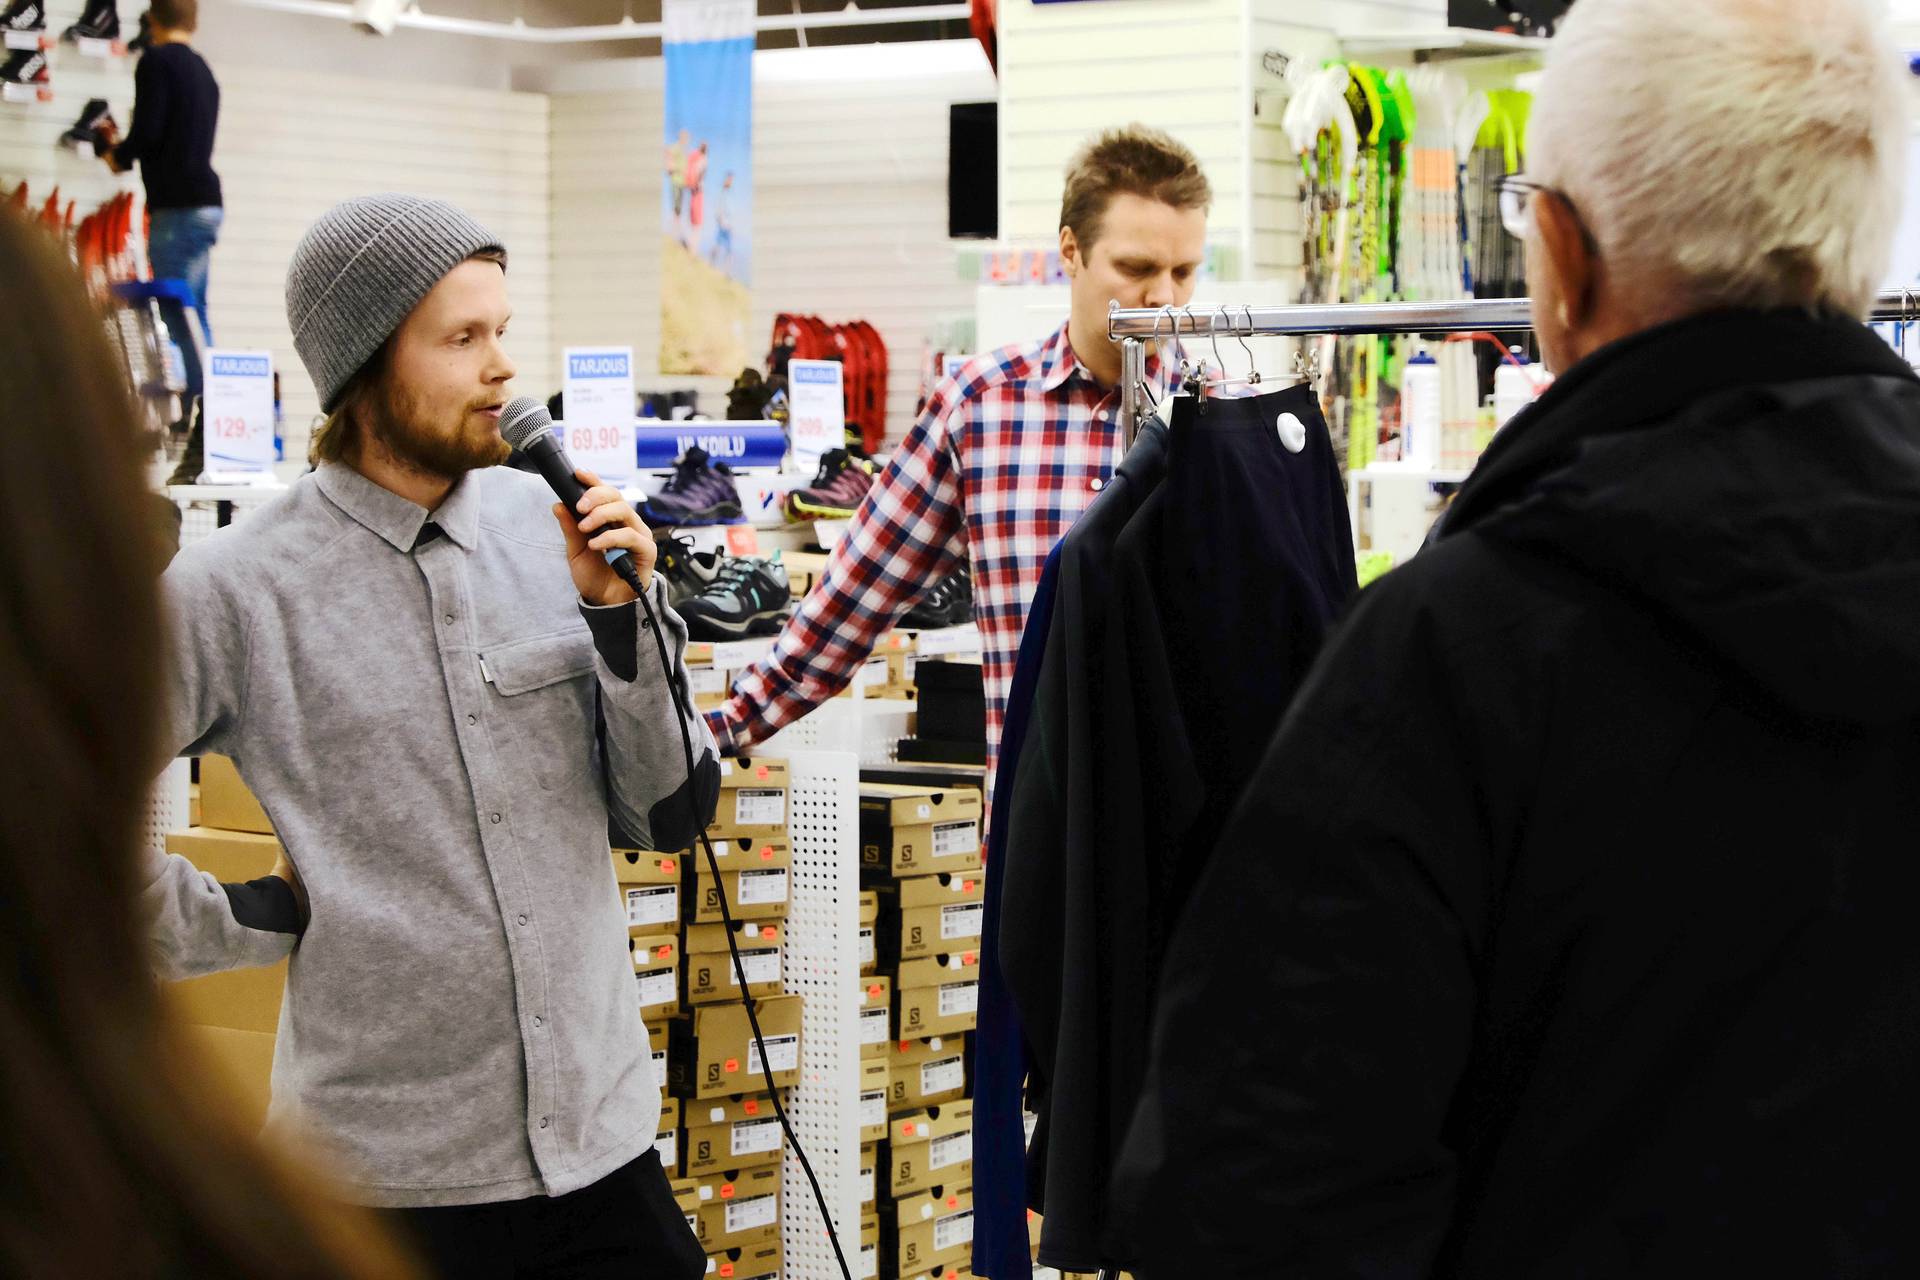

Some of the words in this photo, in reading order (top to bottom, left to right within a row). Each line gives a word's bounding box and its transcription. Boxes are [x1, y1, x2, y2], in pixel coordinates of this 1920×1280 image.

[213, 359, 268, 374] TARJOUS
[571, 358, 627, 375] TARJOUS
[572, 427, 619, 452] 69,90
